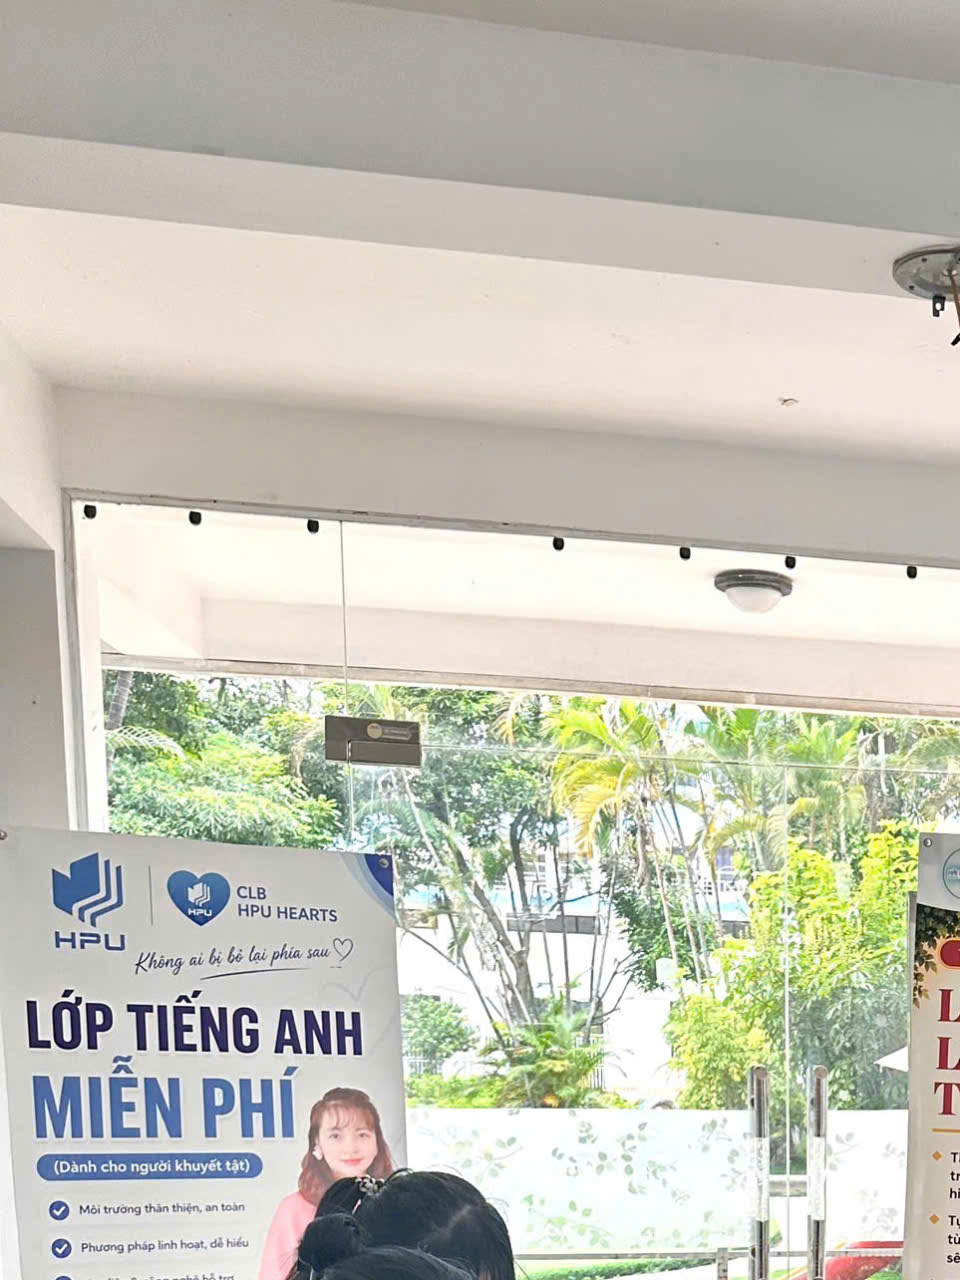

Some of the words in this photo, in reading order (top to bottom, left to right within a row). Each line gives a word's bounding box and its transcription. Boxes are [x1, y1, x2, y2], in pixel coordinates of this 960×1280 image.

[237, 886, 266, 900] CLB
[187, 908, 213, 917] HPU
[238, 903, 272, 919] HPU
[277, 906, 338, 923] HEARTS
[54, 931, 126, 951] HPU
[135, 951, 183, 977] Không
[189, 951, 203, 967] ai
[209, 947, 223, 967] bị
[227, 947, 243, 964] bỏ
[248, 945, 267, 963] lại
[270, 945, 301, 970] phía
[307, 947, 330, 959] sau
[25, 989, 113, 1051] LỚP
[126, 990, 260, 1054] TIẾNG
[273, 1009, 363, 1056] ANH
[32, 1055, 181, 1138] MIỄN
[202, 1066, 299, 1138] PHÍ
[54, 1158, 96, 1175] (Dành
[100, 1160, 127, 1174] cho
[131, 1159, 172, 1177] người
[174, 1157, 223, 1176] khuyết
[224, 1158, 251, 1175] tật)
[79, 1203, 101, 1215] Môi
[103, 1203, 142, 1216] trường
[145, 1202, 169, 1213] thân
[172, 1202, 203, 1215] thiện,
[205, 1204, 219, 1212] an
[221, 1202, 245, 1212] toàn
[81, 1242, 124, 1254] Phương
[127, 1240, 155, 1254] pháp
[158, 1239, 178, 1250] linh
[180, 1238, 208, 1251] hoạt,
[210, 1236, 224, 1249] dễ
[226, 1235, 249, 1248] hiểu
